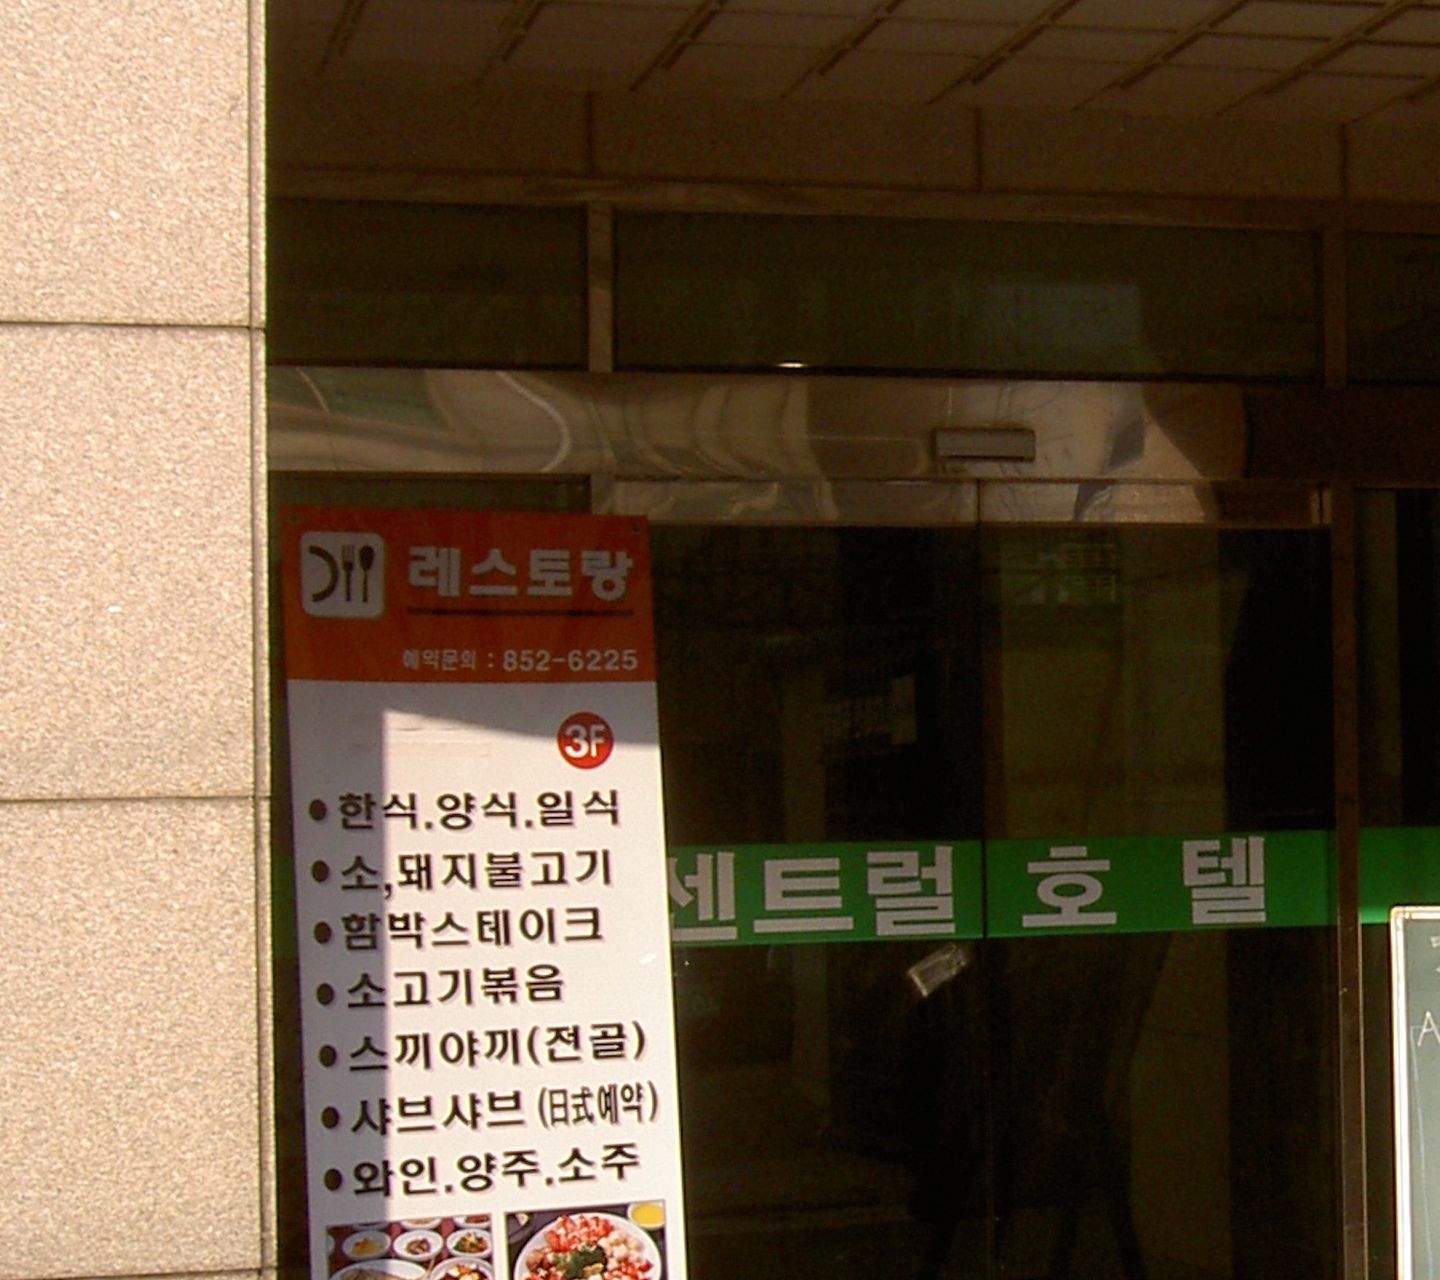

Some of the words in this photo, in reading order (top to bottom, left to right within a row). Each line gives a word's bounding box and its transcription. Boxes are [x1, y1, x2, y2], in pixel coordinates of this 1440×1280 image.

[407, 543, 634, 602] 레스토랑
[403, 648, 477, 671] 예약문의
[503, 648, 638, 671] 852-6225
[564, 723, 605, 760] 3F
[338, 790, 620, 832] 한식.양식.일식
[341, 849, 613, 899] 소,돼지불고기
[669, 845, 957, 941] 센트럴
[341, 907, 604, 951] 함박스테이크
[347, 964, 565, 1009] 소고기볶음
[349, 1022, 647, 1072] 스끼야끼(전골)
[351, 1090, 527, 1136] 샤브샤브
[353, 1142, 640, 1197] 와인.양주.소주
